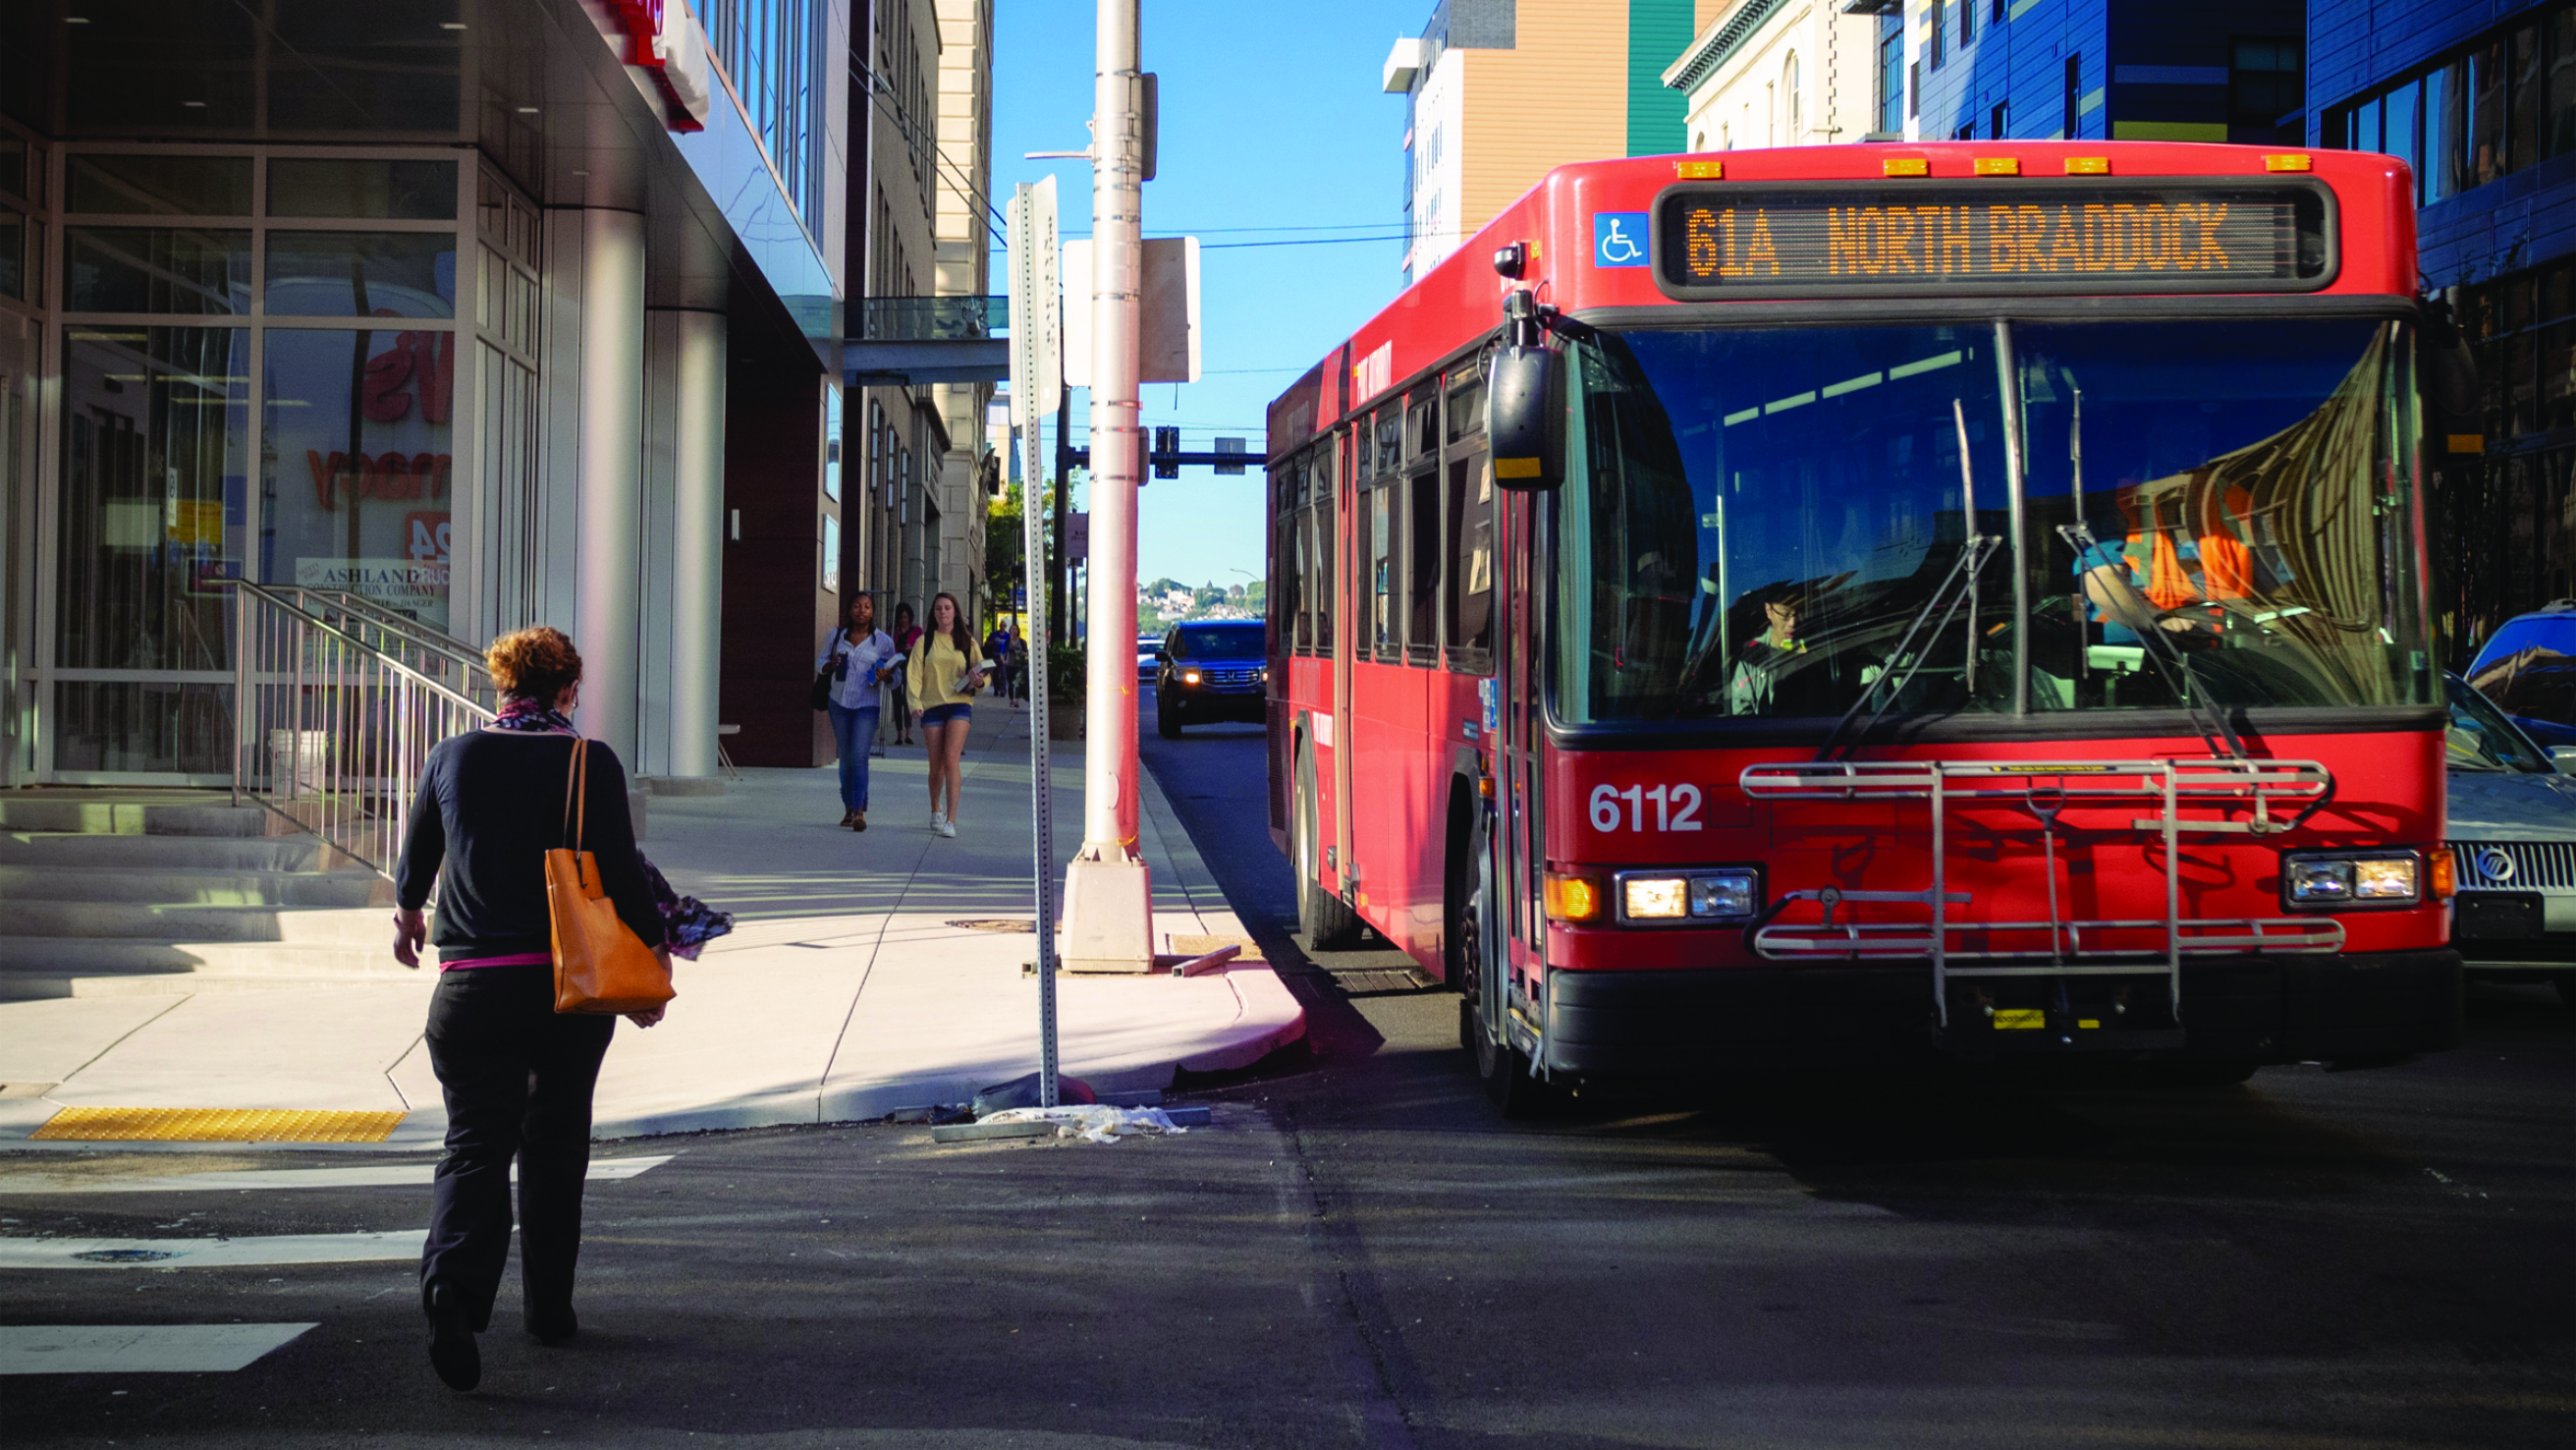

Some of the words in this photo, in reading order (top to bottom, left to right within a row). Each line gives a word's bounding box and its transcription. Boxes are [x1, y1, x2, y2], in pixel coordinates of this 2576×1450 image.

[1688, 208, 1780, 277] 61A
[1829, 205, 1971, 274] NORTH
[1989, 202, 2228, 272] BRADDOCK
[323, 569, 420, 584] ASHLAND
[388, 583, 436, 596] COMPANY
[400, 598, 434, 607] DANGER
[1589, 783, 1703, 833] 6112
